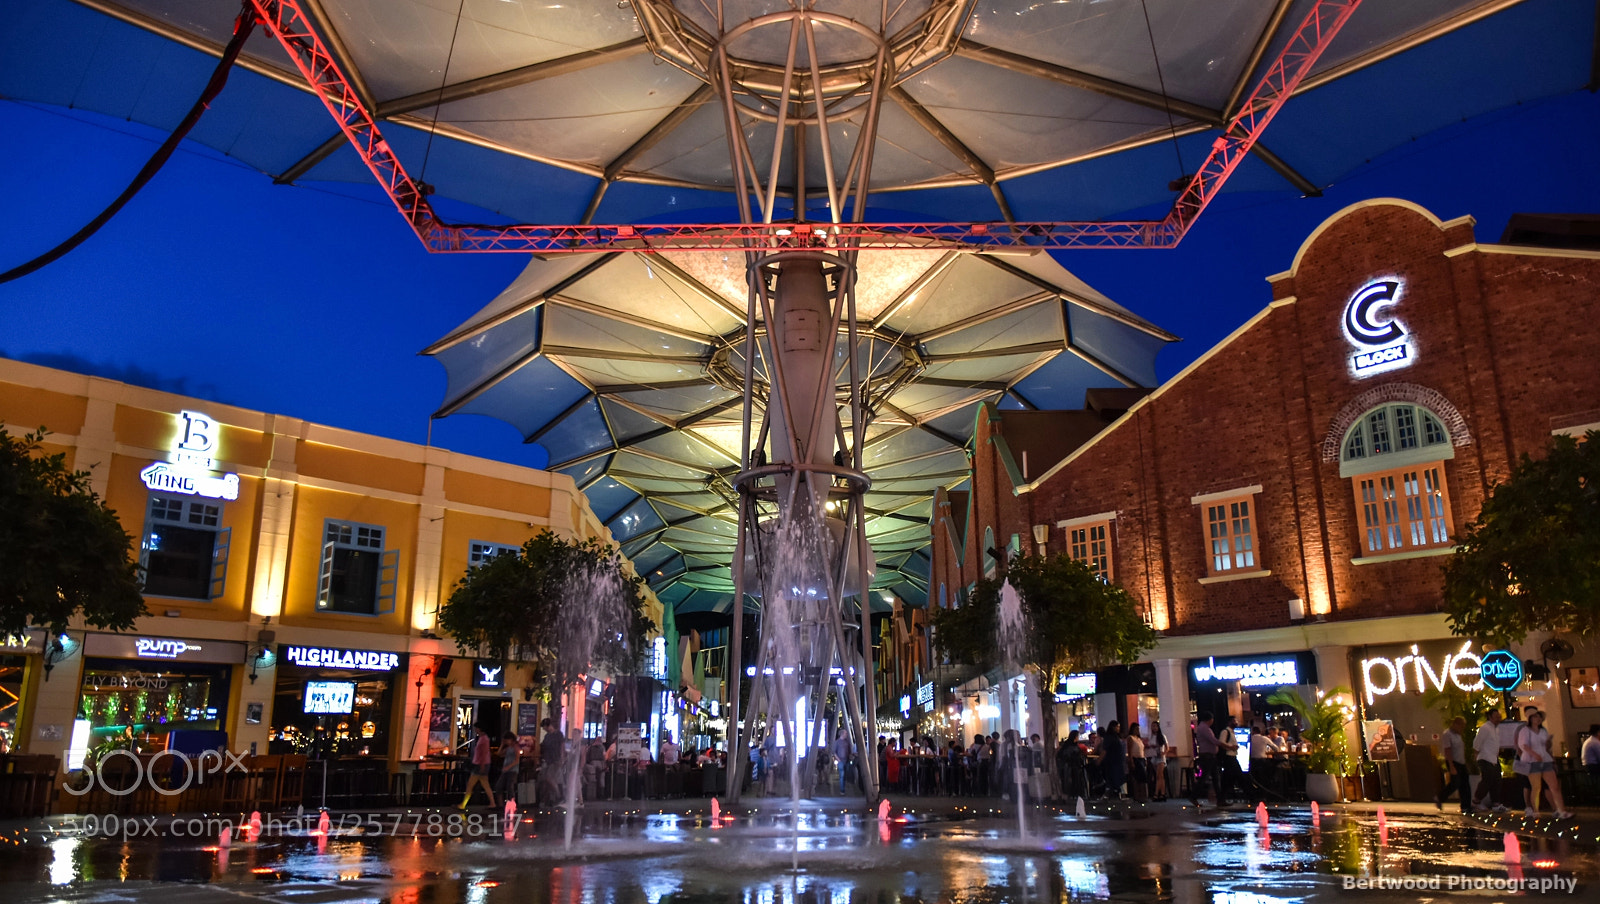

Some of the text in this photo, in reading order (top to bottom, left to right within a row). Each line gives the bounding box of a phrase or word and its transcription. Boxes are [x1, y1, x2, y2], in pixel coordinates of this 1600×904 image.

[1344, 280, 1405, 346] C
[1355, 345, 1404, 369] BLOCK
[0, 633, 32, 648] RY
[287, 647, 399, 668] HIGHLANDER
[1482, 658, 1517, 678] privé
[84, 676, 106, 687] FLY
[1361, 639, 1485, 706] privé
